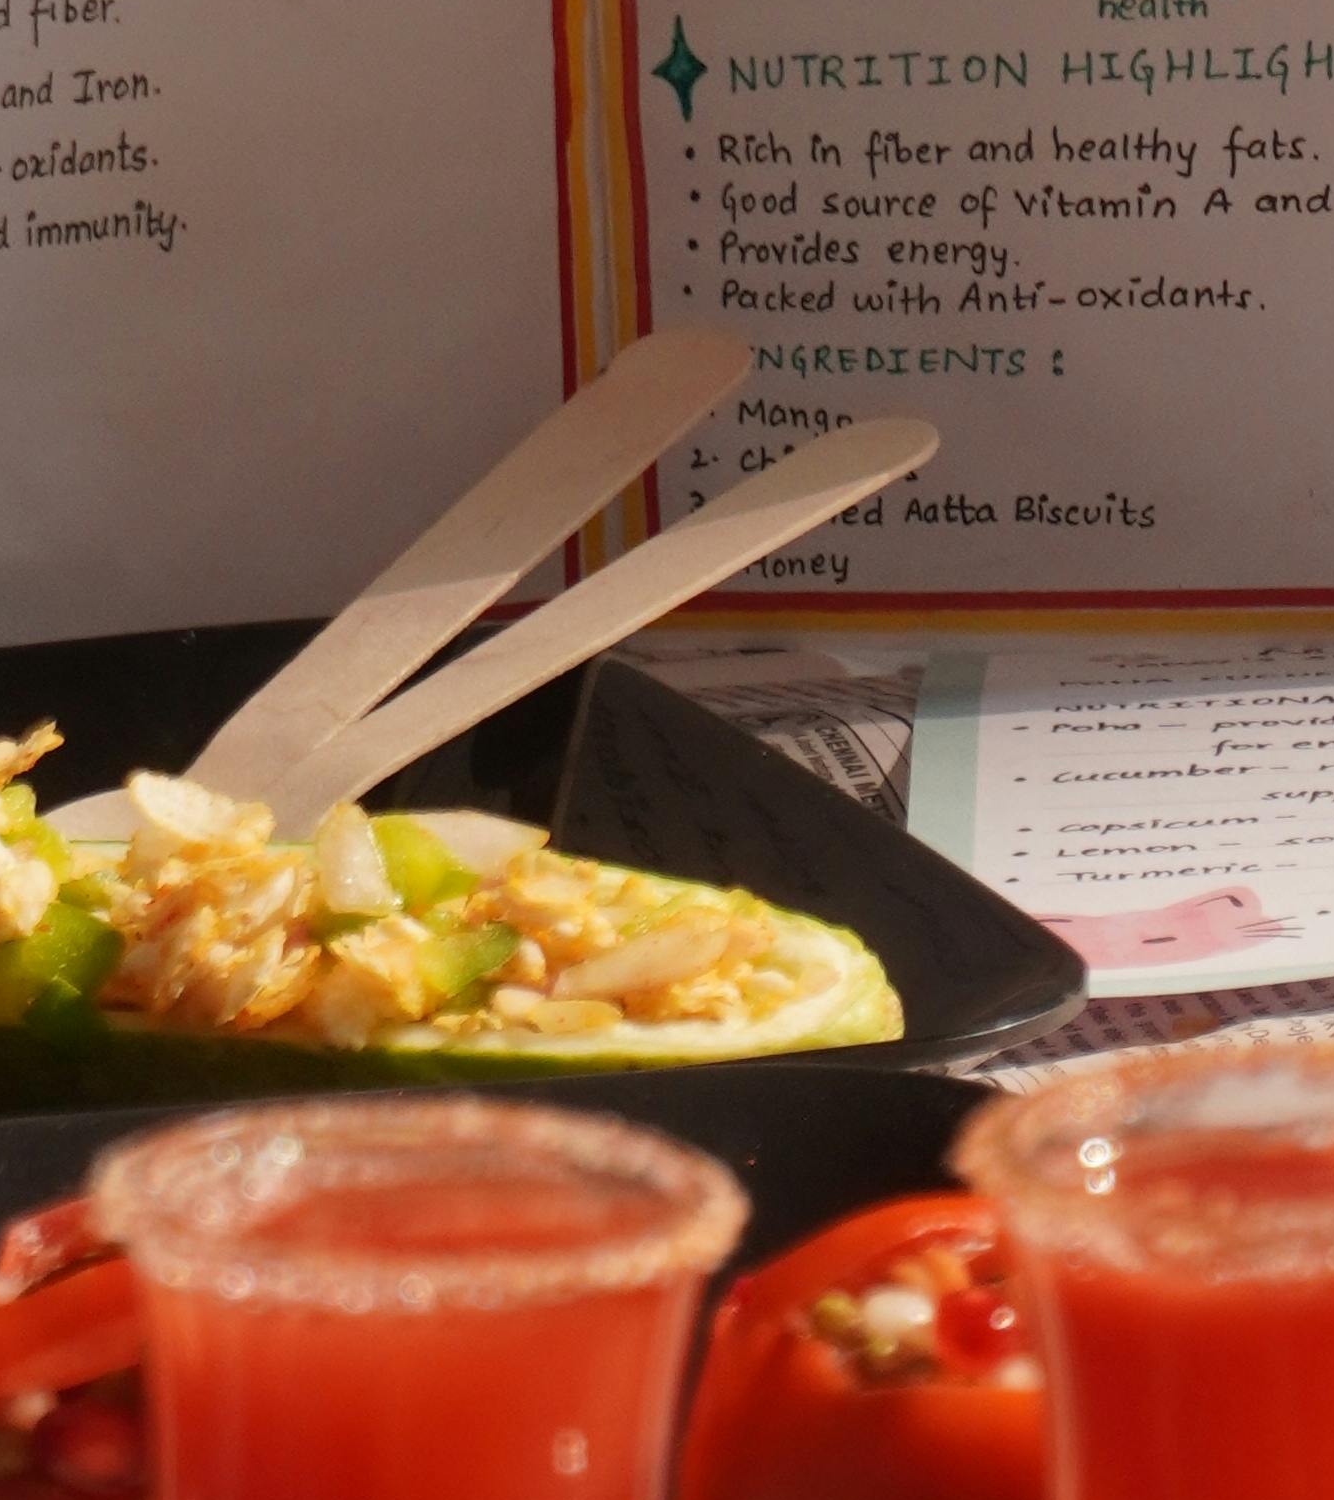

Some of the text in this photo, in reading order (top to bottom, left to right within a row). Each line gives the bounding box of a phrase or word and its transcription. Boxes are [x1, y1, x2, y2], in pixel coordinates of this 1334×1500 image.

[0, 71, 53, 109] and
[72, 68, 161, 105] Iron.
[729, 51, 1027, 94] NUTRITION
[718, 124, 1319, 180] Rich in fiber and healthy fats.
[26, 199, 187, 253] immunity.
[721, 180, 797, 224] Good
[822, 192, 936, 219] source
[959, 184, 998, 230] of
[1013, 182, 1176, 219] Vitamin
[1203, 187, 1233, 216] A
[1254, 184, 1332, 214] and
[720, 229, 1020, 279] Provides energy.
[721, 278, 835, 313] Packed
[852, 279, 941, 315] with
[904, 493, 998, 527] Aatta
[1015, 491, 1156, 529] Biscuits
[814, 727, 871, 778] CHENNAI
[1212, 740, 1274, 757] for
[1057, 843, 1199, 858] Lemon
[1058, 863, 1265, 882] Turmeric
